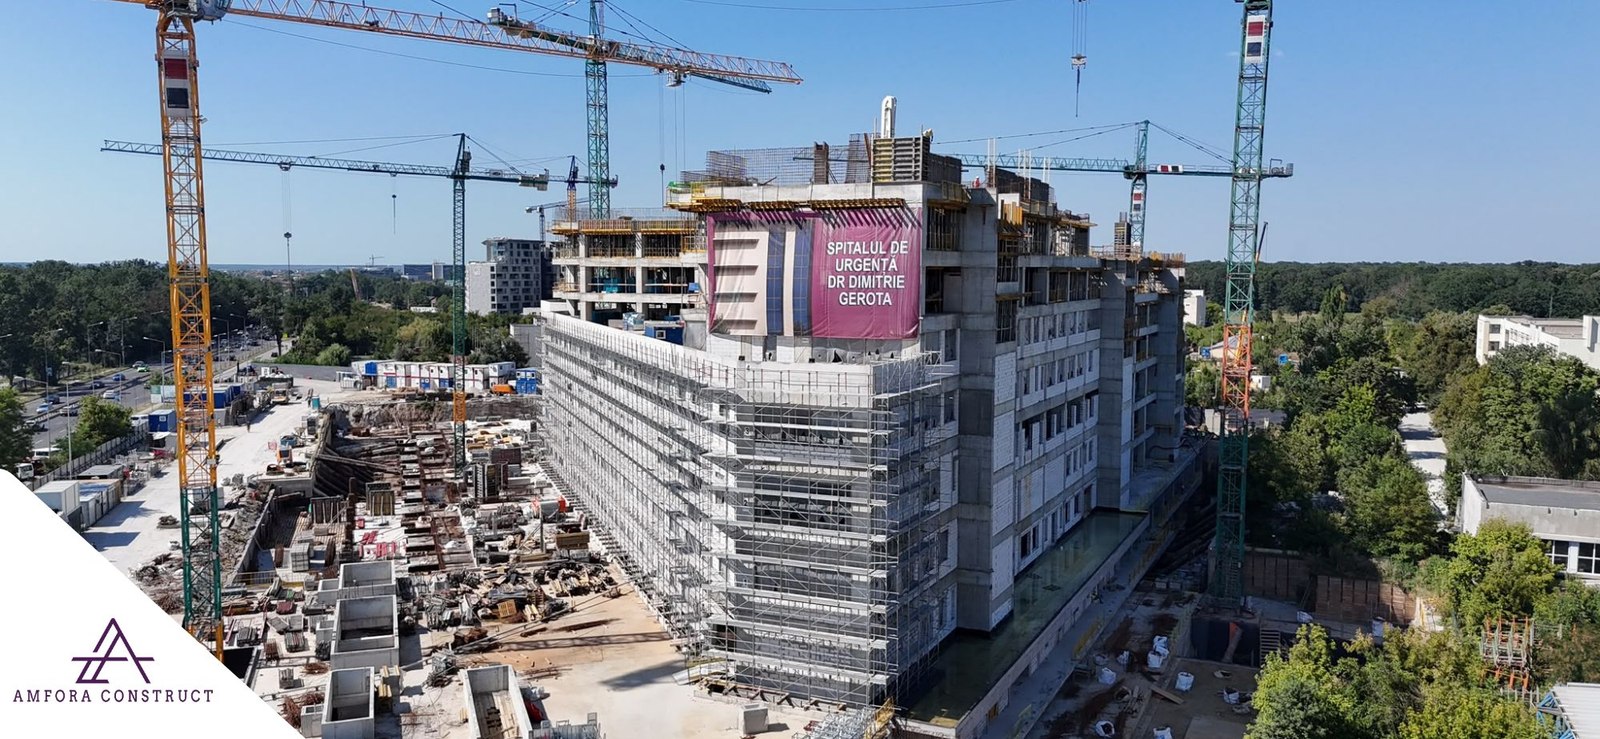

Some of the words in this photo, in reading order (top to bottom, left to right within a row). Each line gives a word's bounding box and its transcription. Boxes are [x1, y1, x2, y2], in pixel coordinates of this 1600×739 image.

[827, 241, 886, 255] SPITALUL
[891, 241, 909, 254] DE
[828, 275, 845, 289] DR
[849, 275, 905, 289] DIMITRIE
[839, 292, 892, 306] GEROTA
